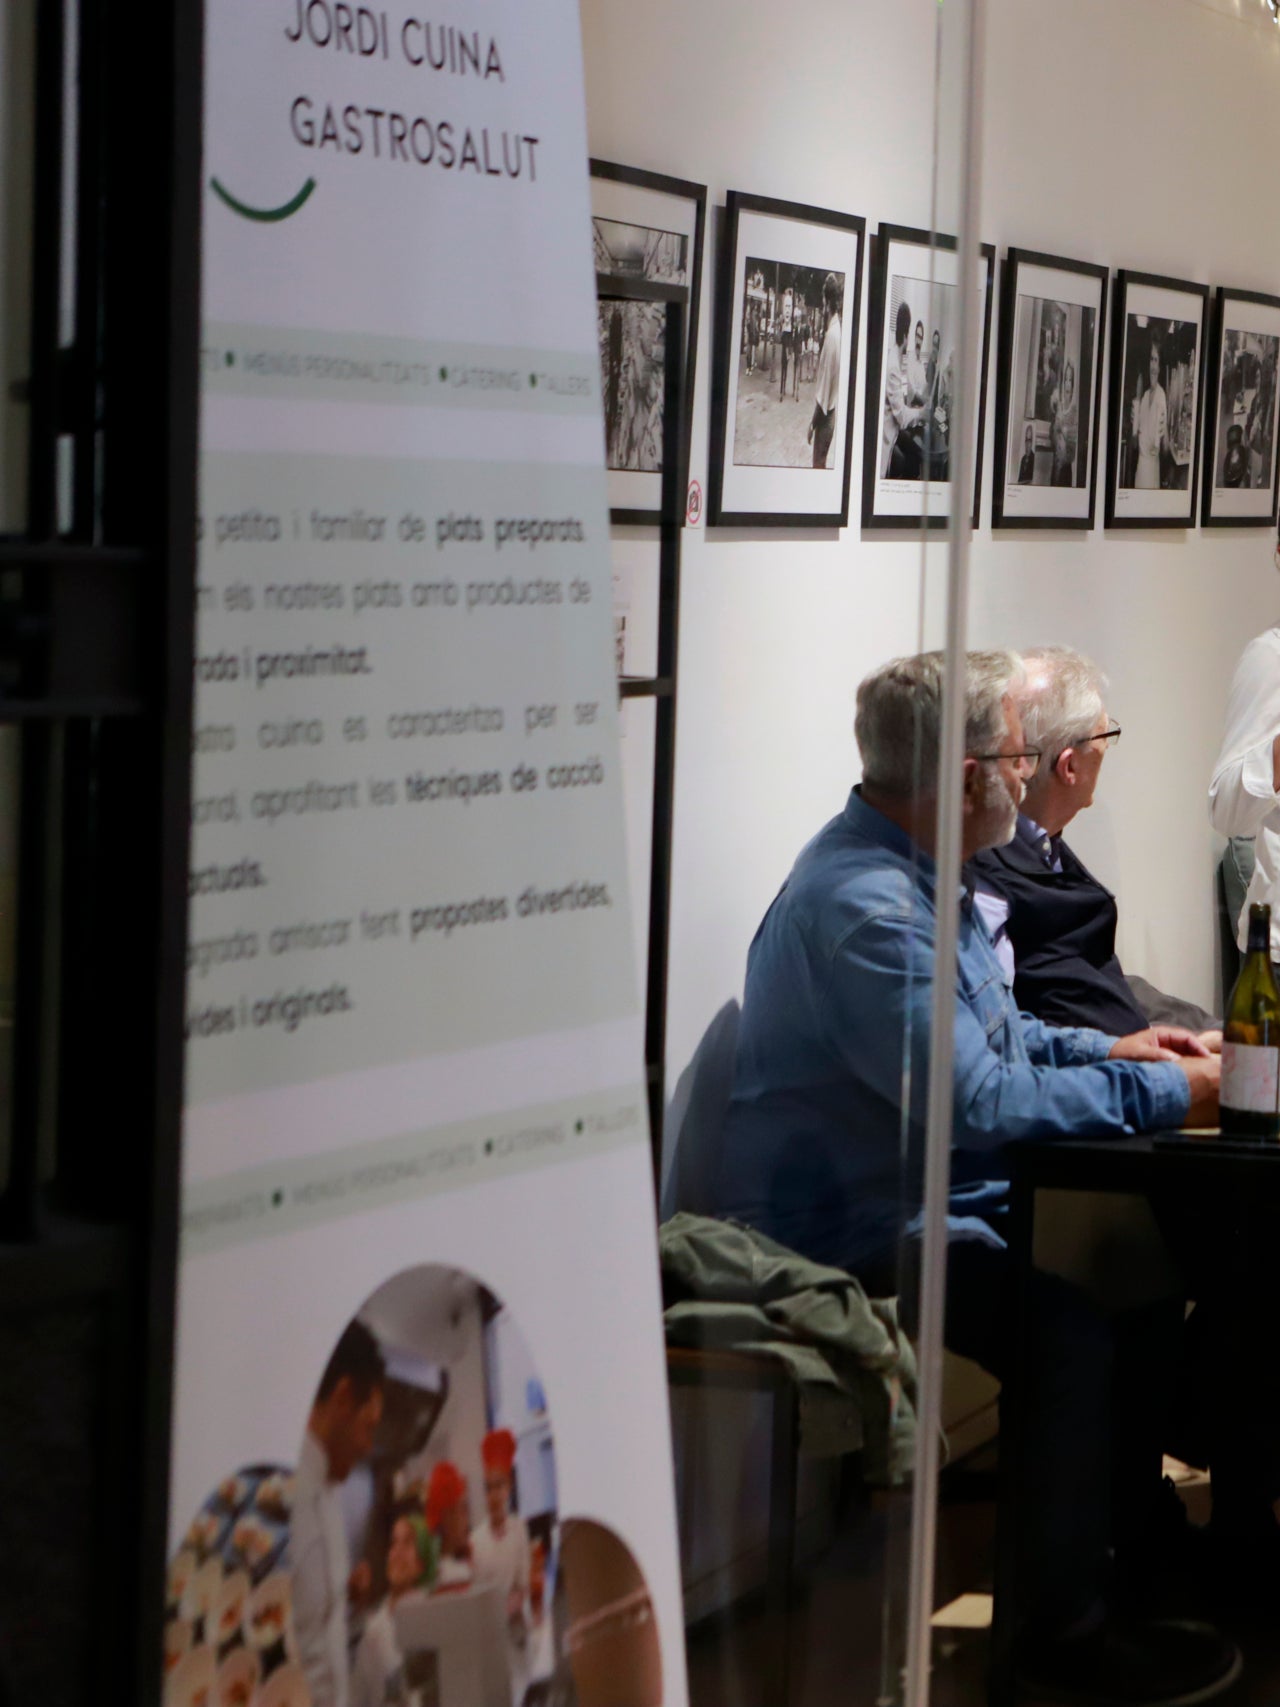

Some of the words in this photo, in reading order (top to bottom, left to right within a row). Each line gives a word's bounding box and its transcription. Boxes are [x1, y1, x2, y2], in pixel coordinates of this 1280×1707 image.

[285, 0, 388, 60] JORDI
[402, 18, 505, 82] CUINA
[290, 95, 540, 182] GASTROSALUT
[215, 510, 281, 552] petita
[310, 507, 386, 542] familiar
[398, 510, 425, 542] de
[436, 511, 484, 552] plats
[224, 579, 253, 613] els
[264, 579, 344, 612] nostres
[353, 576, 403, 616] plats
[411, 572, 458, 608] amb
[466, 572, 563, 614] productes
[569, 571, 592, 604] de
[258, 714, 323, 750] cuina
[343, 715, 367, 743] es
[525, 701, 557, 738] per
[575, 699, 599, 727] ser
[369, 775, 396, 807] les
[510, 761, 538, 792] de
[411, 895, 509, 944] propostes
